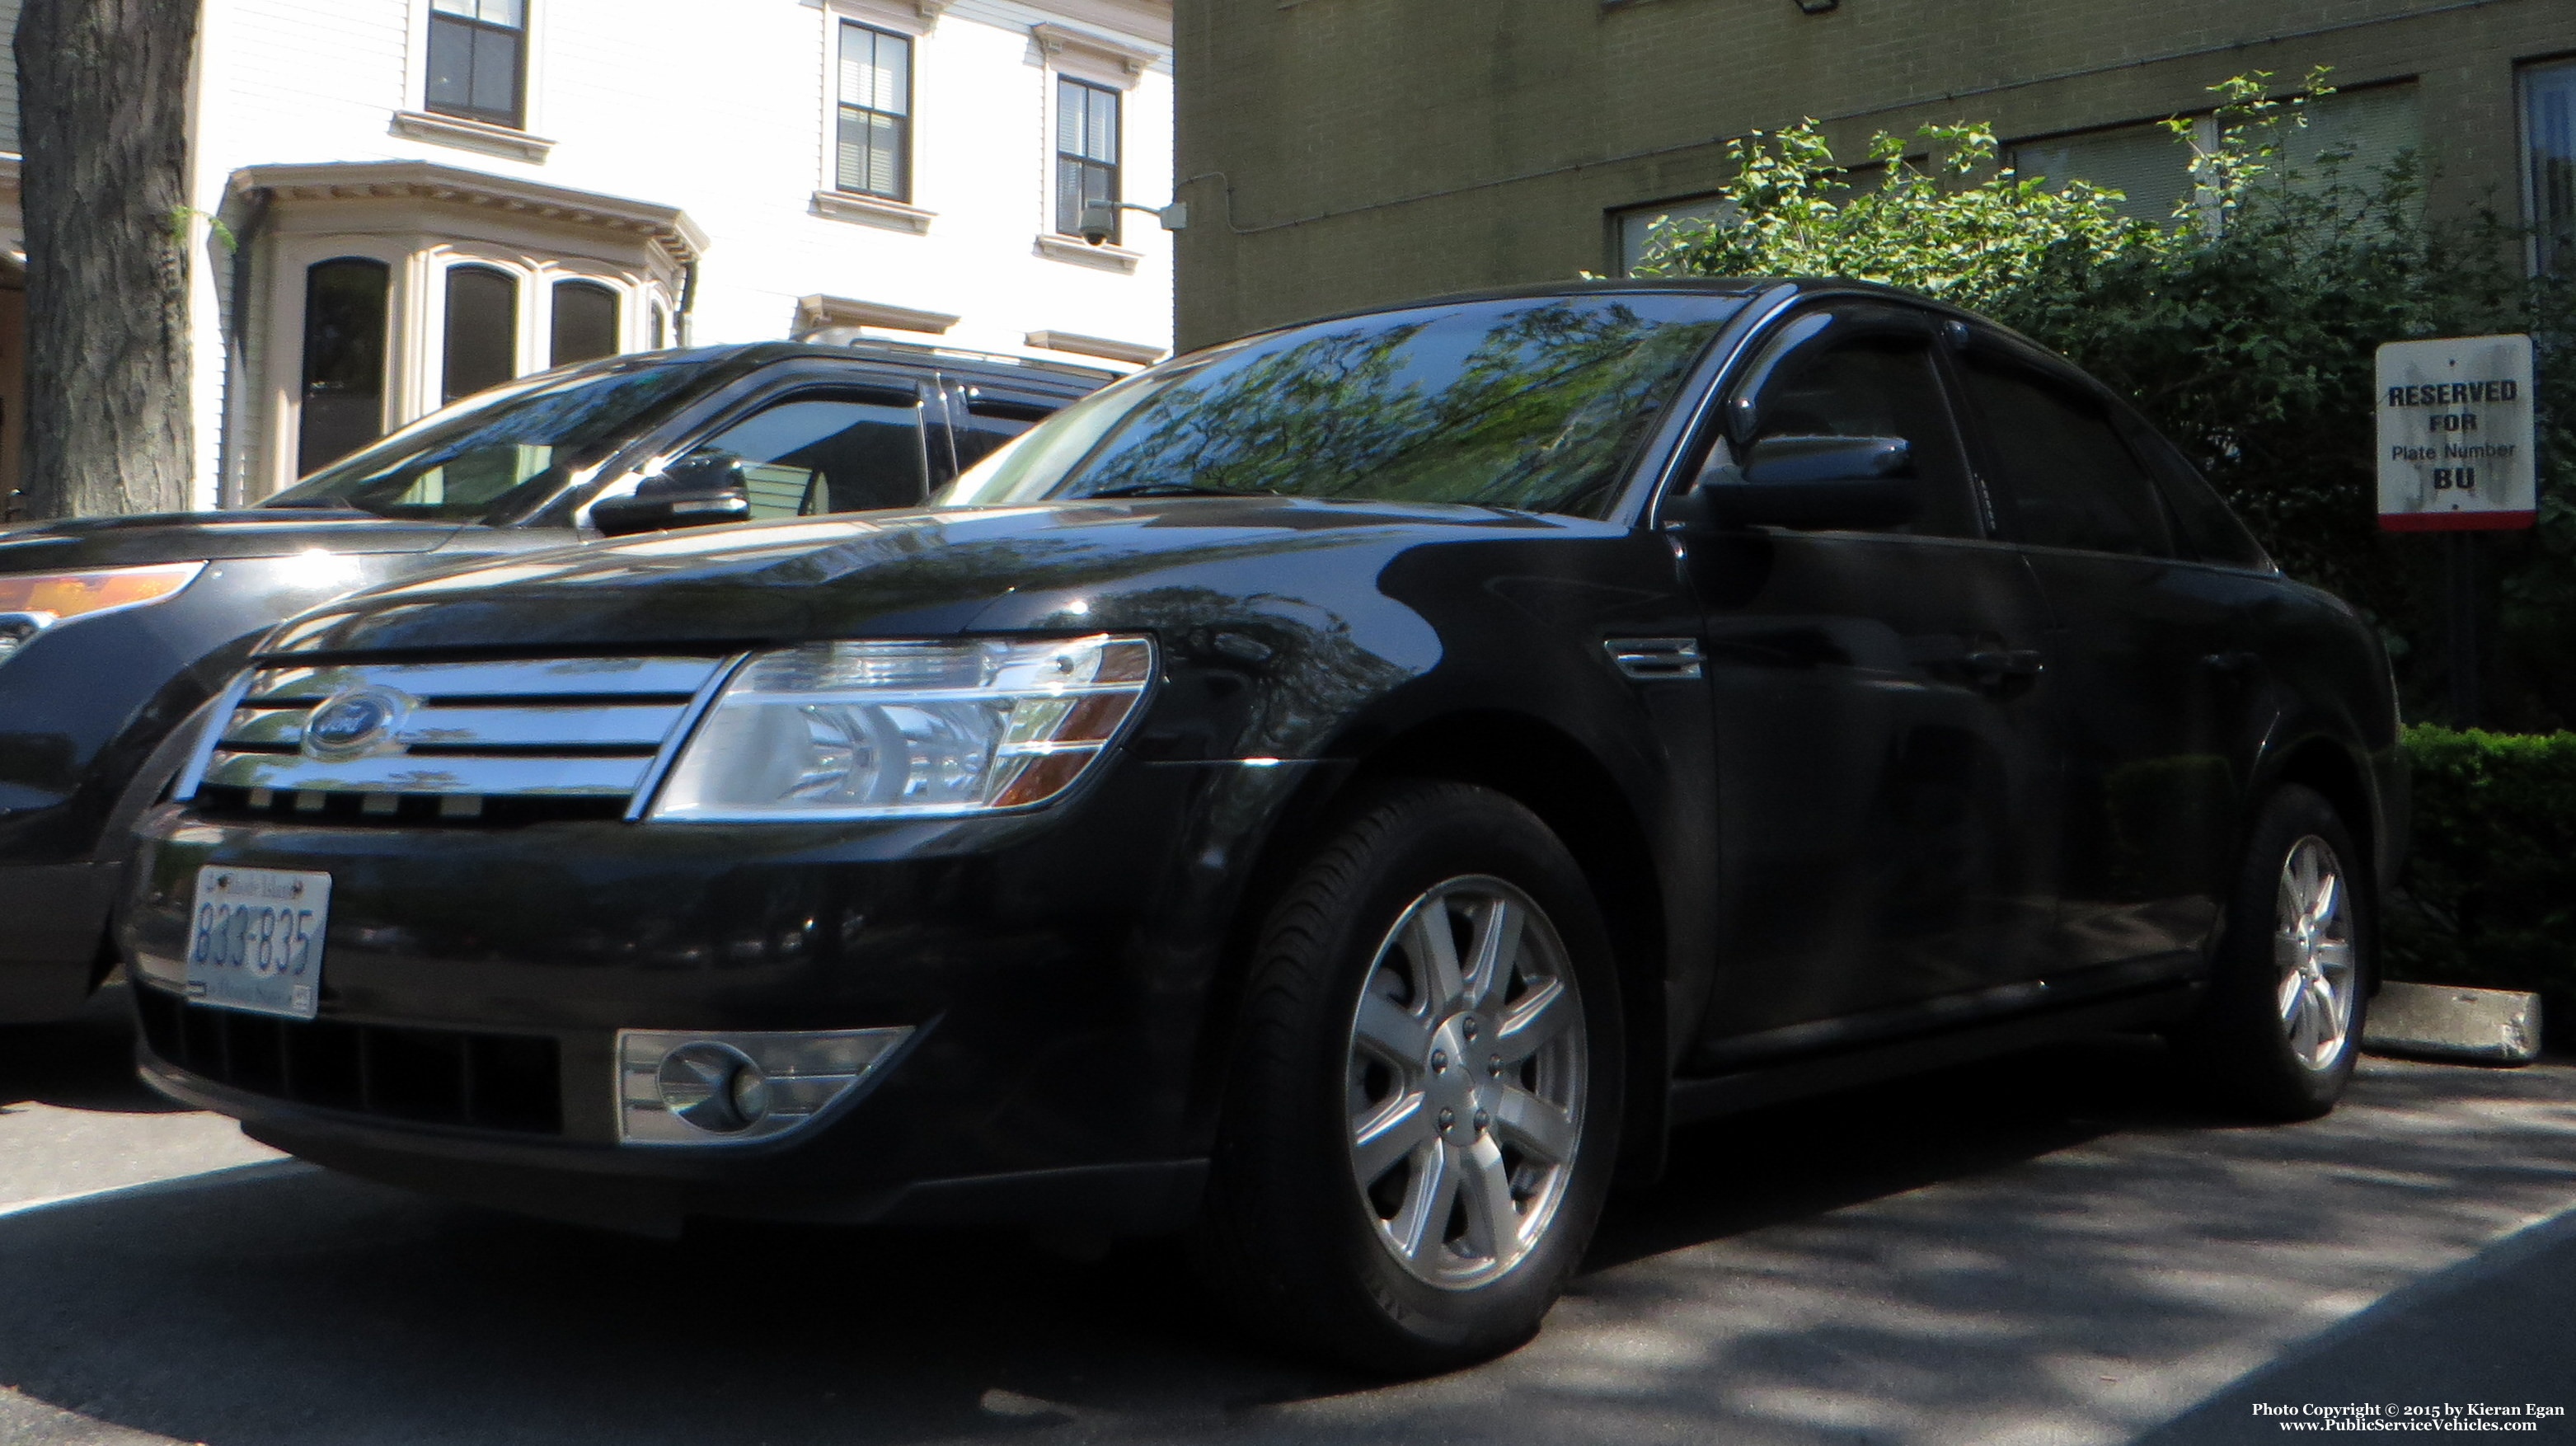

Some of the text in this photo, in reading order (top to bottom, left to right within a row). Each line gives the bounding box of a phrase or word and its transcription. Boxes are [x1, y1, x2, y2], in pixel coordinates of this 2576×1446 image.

[2389, 379, 2517, 406] RESERVED
[2429, 413, 2477, 433] FOR
[2392, 443, 2516, 461] Plate Number
[2433, 467, 2475, 490] BU
[195, 901, 313, 976] 833-835
